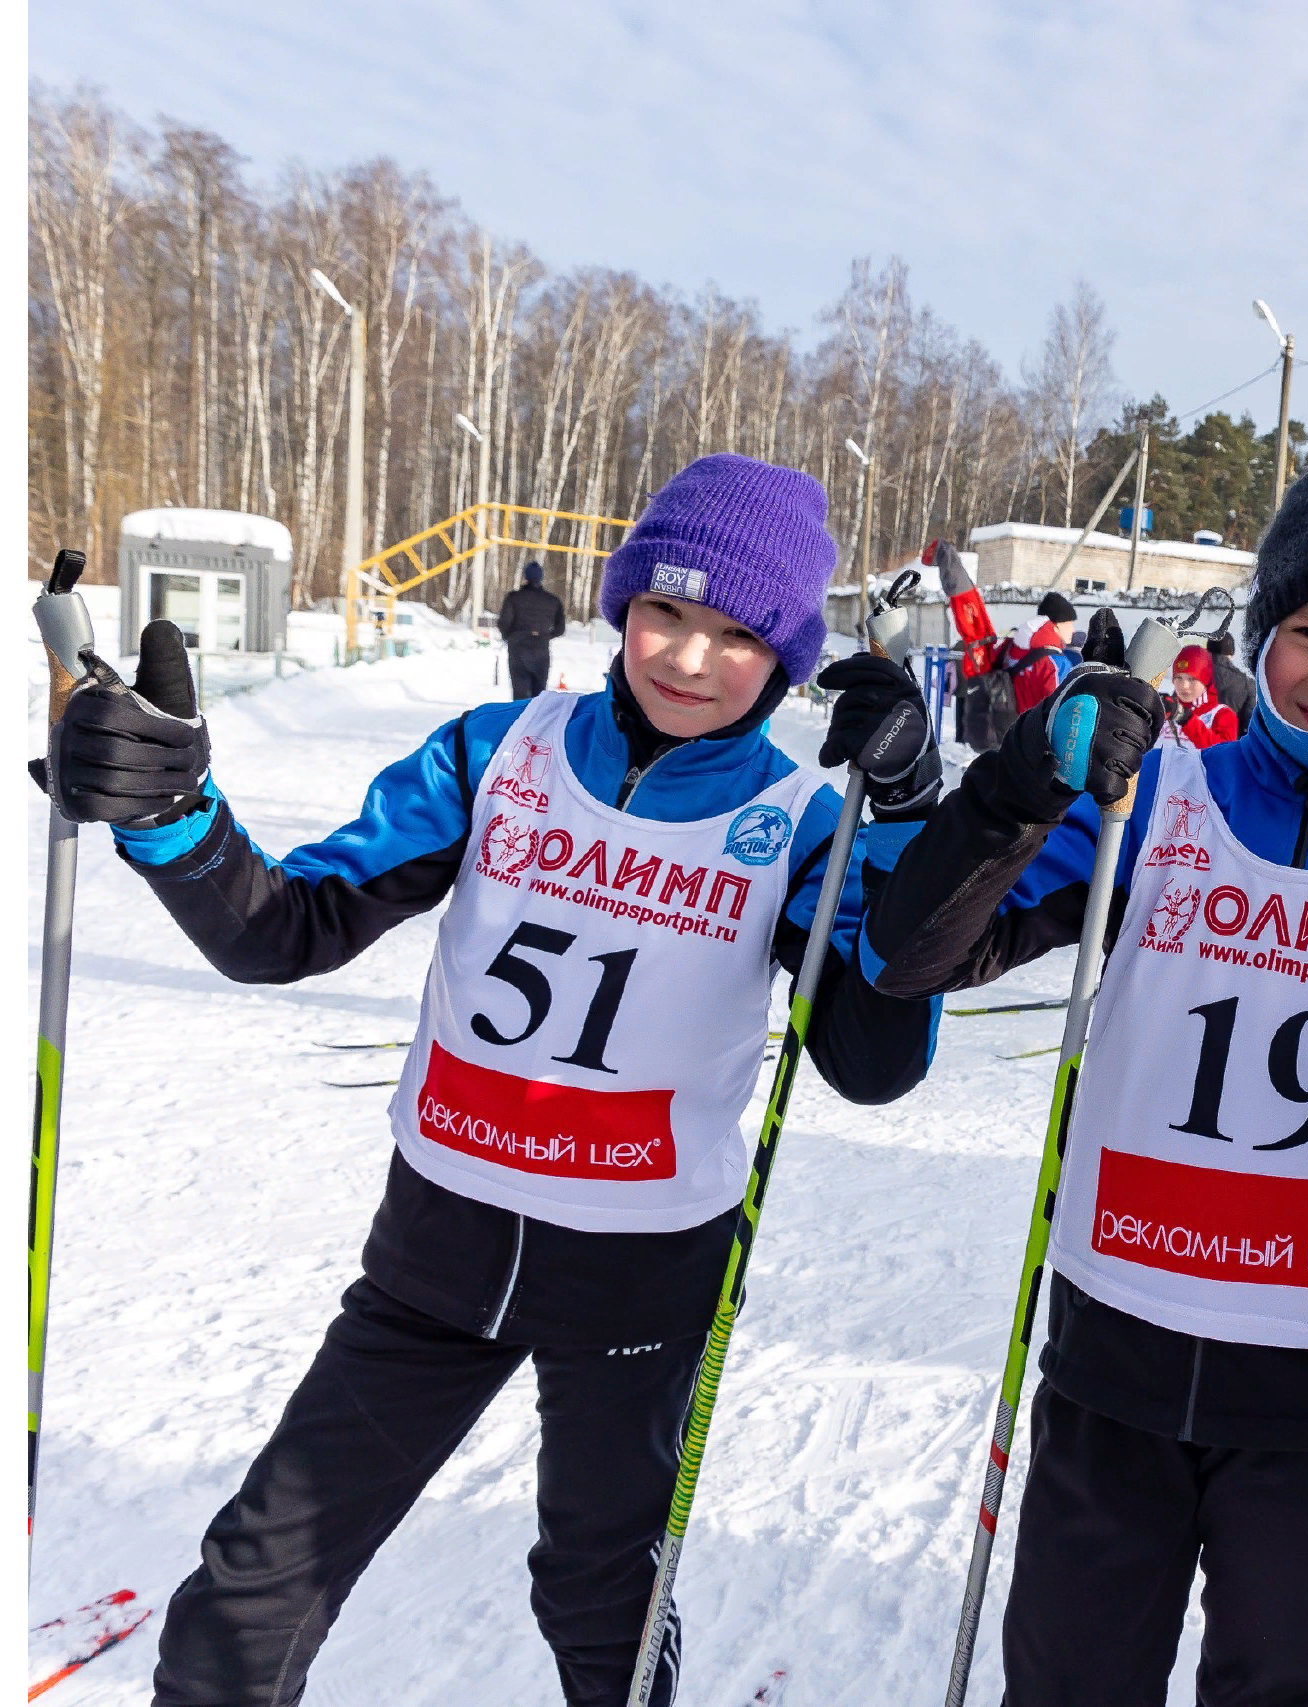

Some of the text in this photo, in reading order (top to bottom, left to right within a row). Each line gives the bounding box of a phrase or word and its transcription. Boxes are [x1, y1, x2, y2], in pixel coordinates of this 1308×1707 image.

[656, 570, 685, 586] BOY
[873, 709, 911, 759] NORDSKI
[475, 861, 521, 889] ОЛИМП
[538, 828, 753, 922] ОЛИМП
[528, 877, 738, 944] www.olimpsportpit.ru
[1139, 935, 1184, 954] ОЛИМП
[471, 922, 638, 1074] 51
[419, 1094, 577, 1163] рекламный
[1099, 1208, 1294, 1271] рекламный
